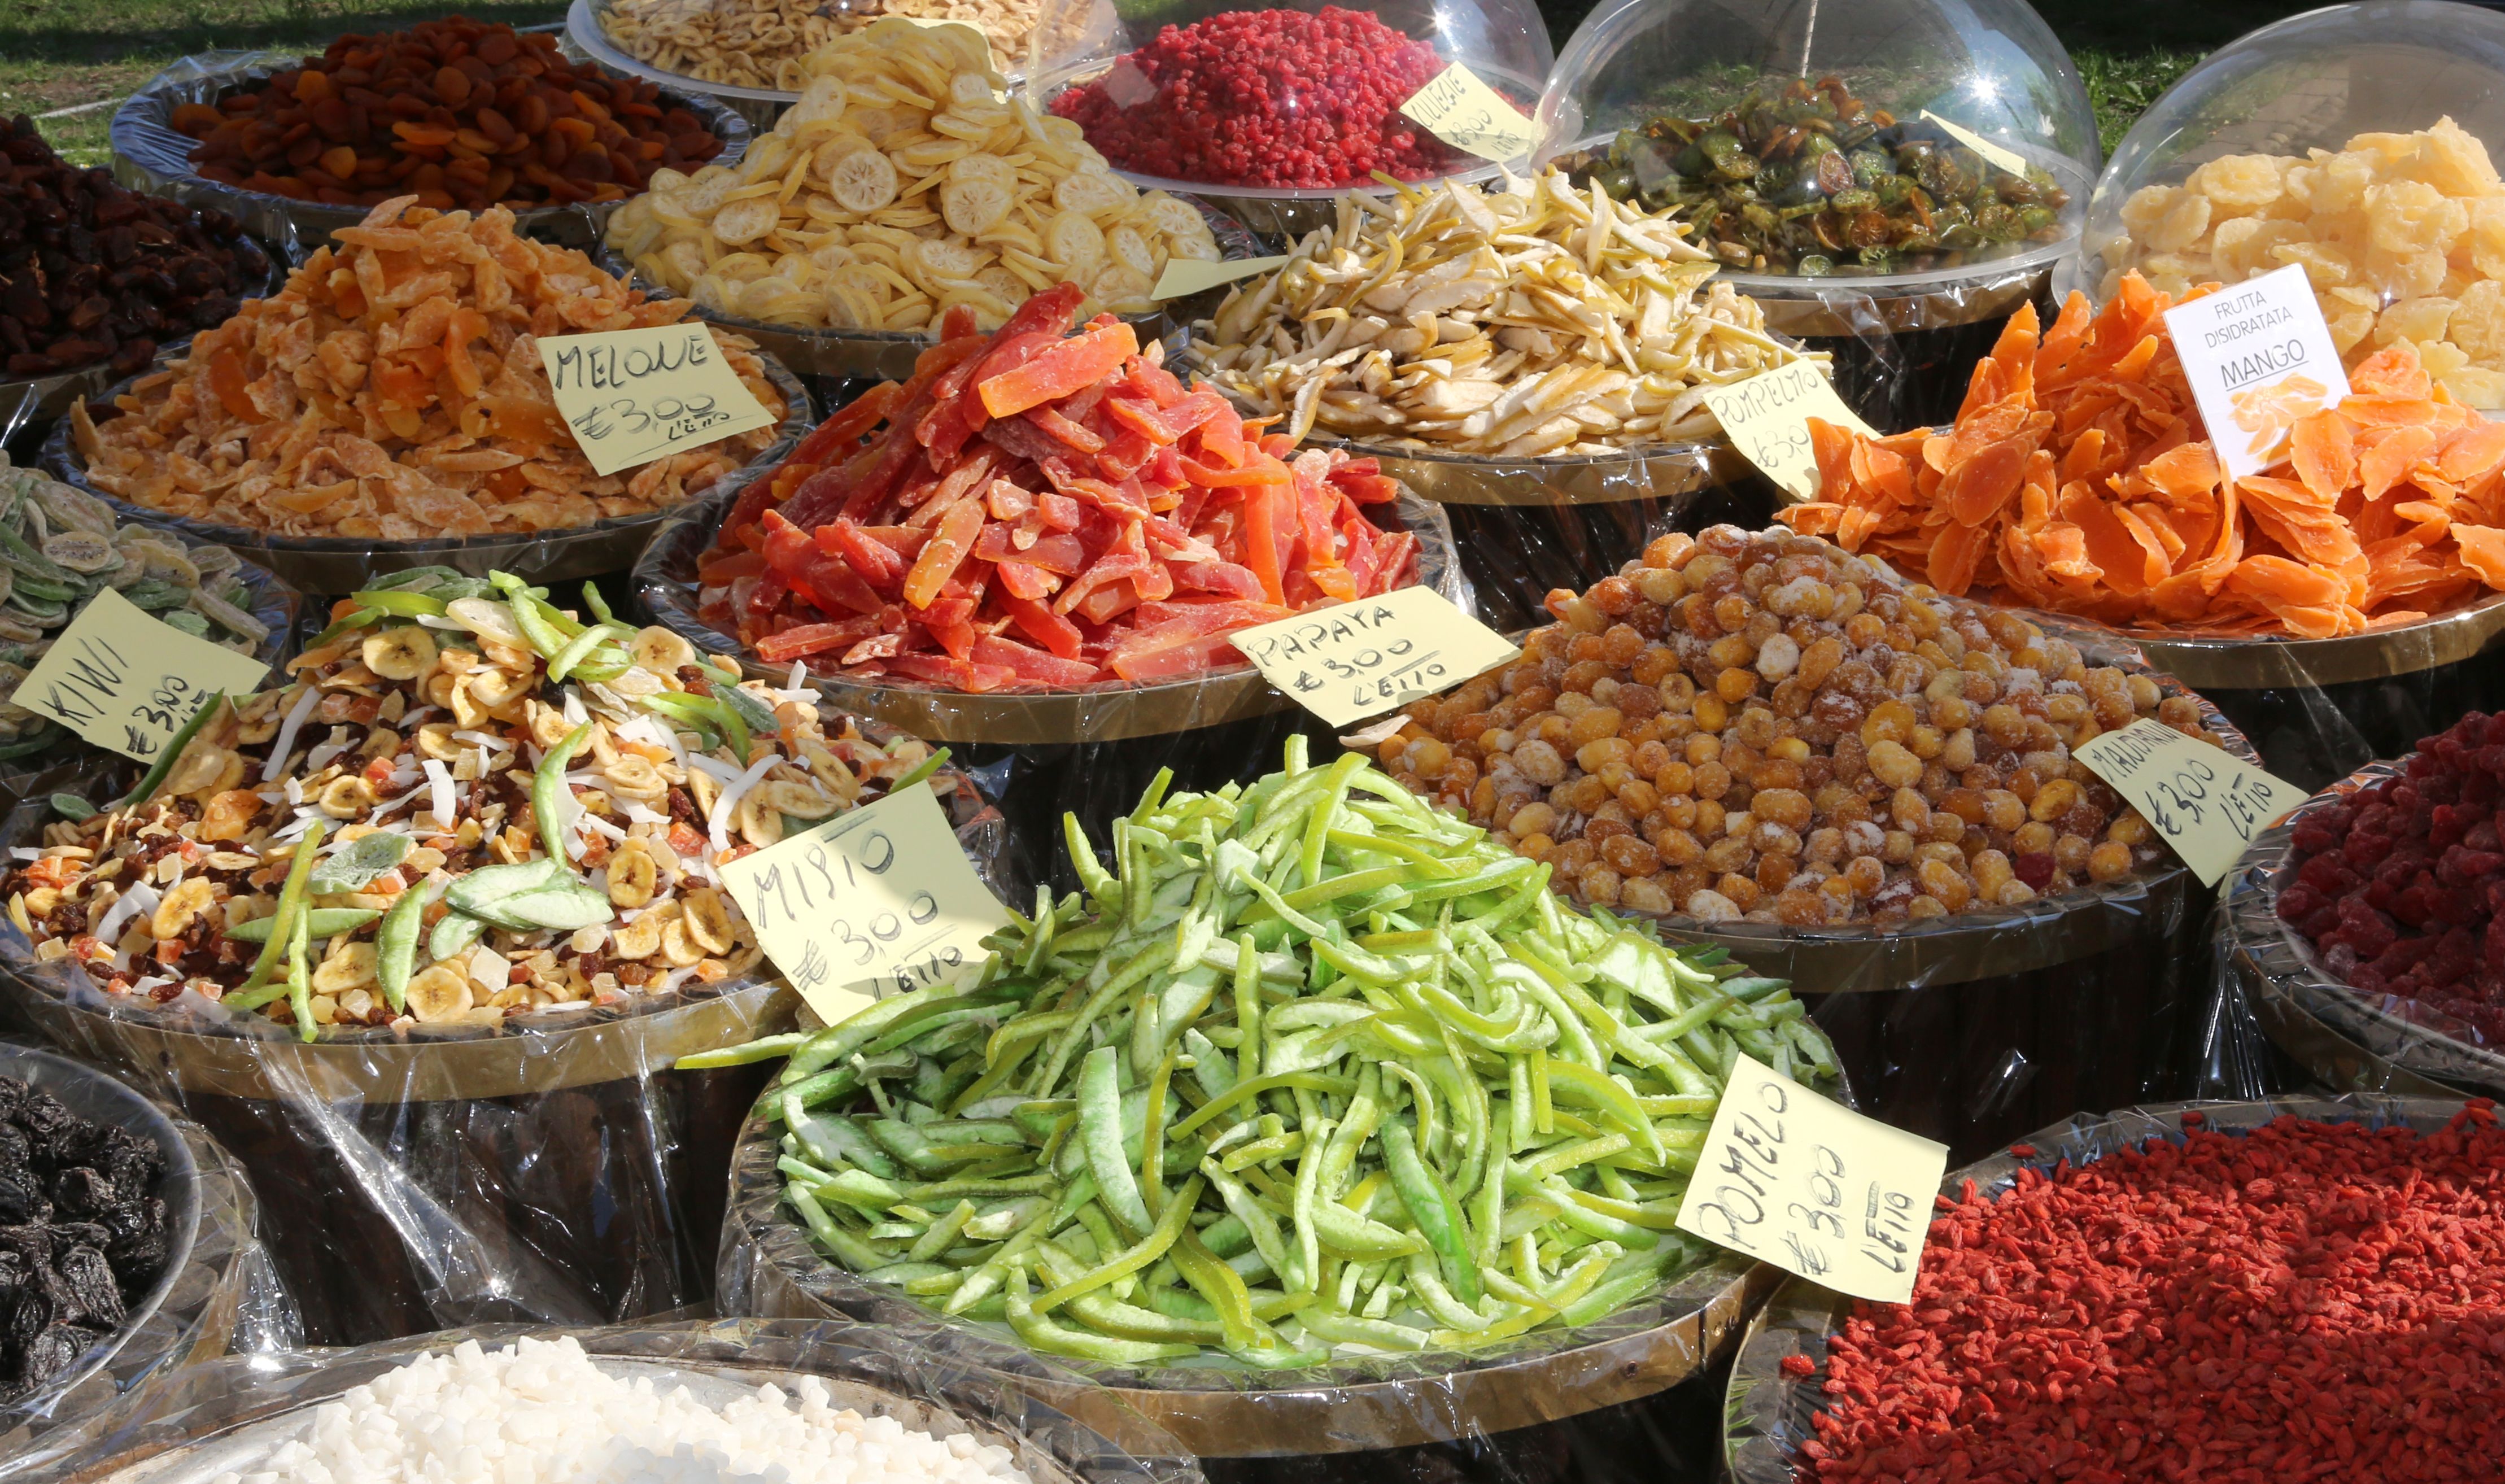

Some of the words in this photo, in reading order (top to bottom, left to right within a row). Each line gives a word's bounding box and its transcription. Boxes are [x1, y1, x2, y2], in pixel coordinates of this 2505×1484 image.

[2205, 306, 2294, 348] DISIDRATATA
[2214, 291, 2267, 320] FRUTTA
[556, 334, 708, 390] MELONE
[2220, 339, 2305, 387] MANGO
[1712, 369, 1819, 427] POMPELMO
[1247, 605, 1396, 667] PAPAYA
[38, 635, 129, 727] KIWI
[1696, 1081, 1789, 1250] POMELO
